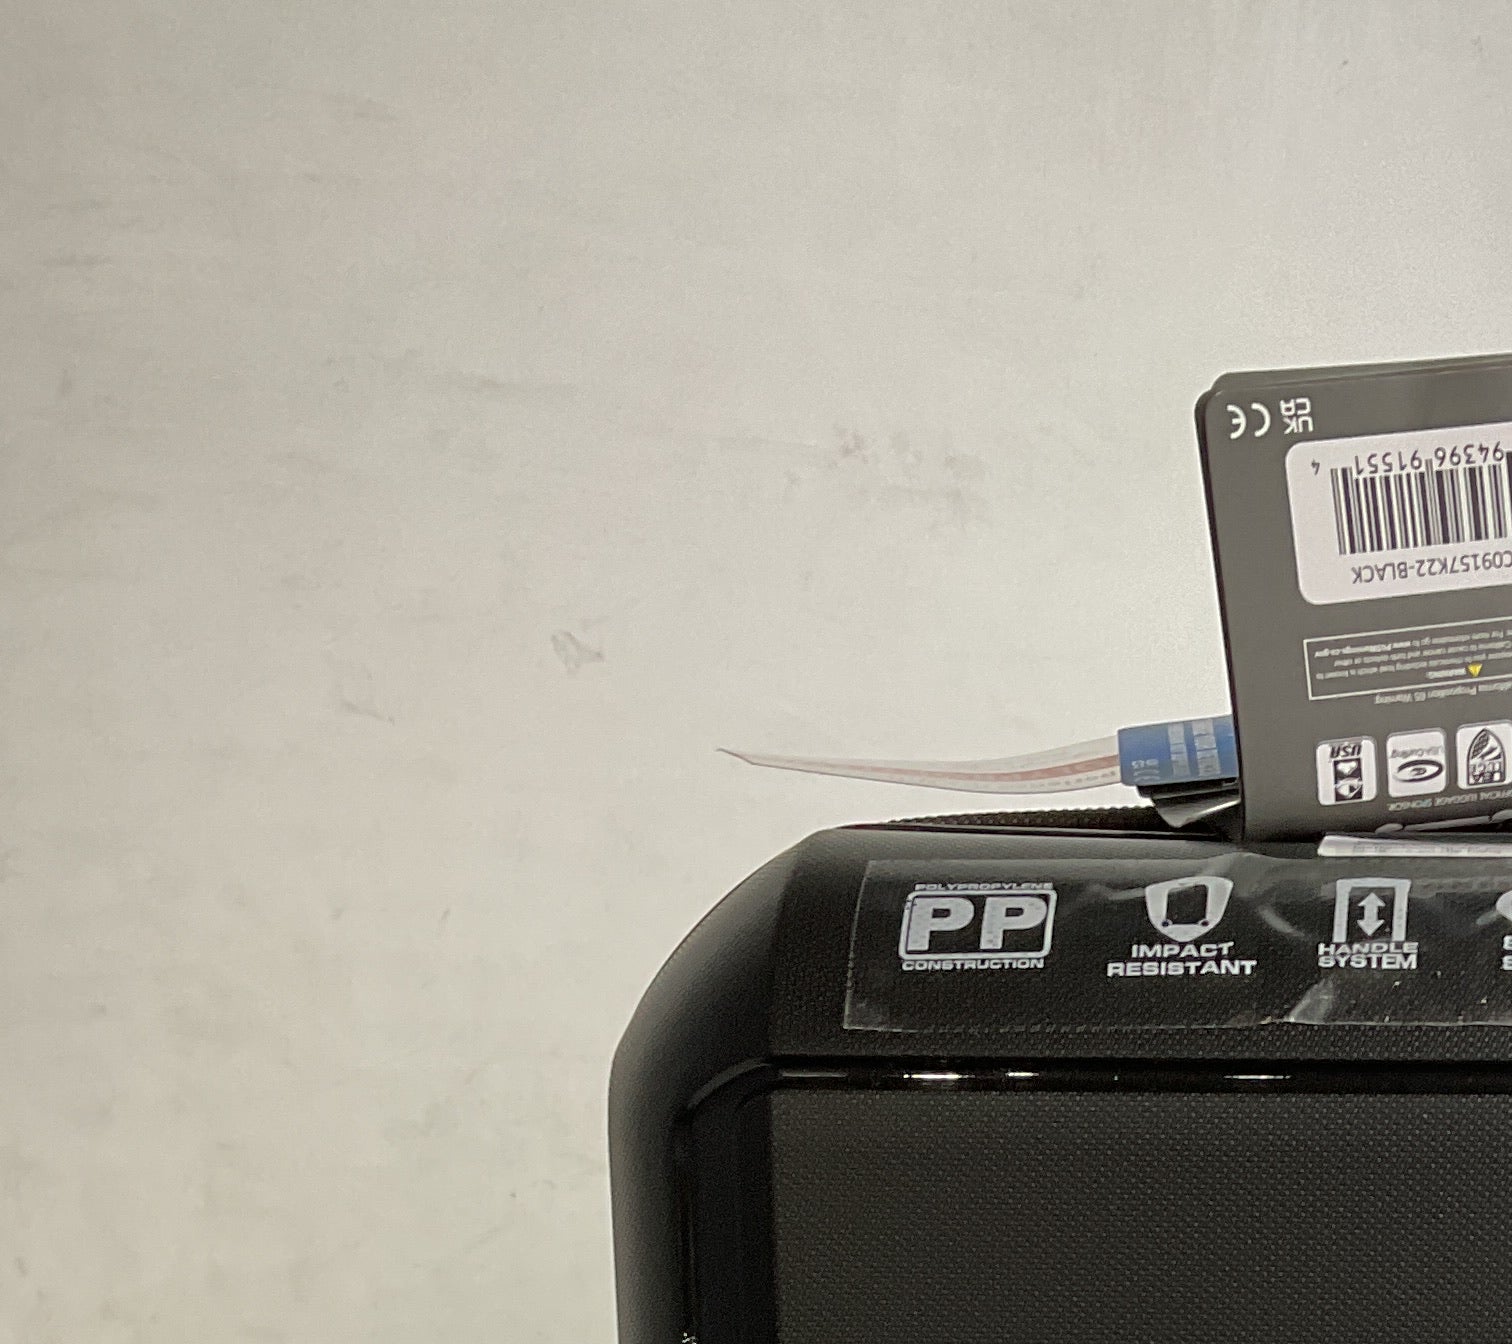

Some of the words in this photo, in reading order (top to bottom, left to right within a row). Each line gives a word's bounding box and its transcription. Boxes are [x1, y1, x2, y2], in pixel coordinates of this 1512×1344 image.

[1280, 398, 1311, 416] CA
[1283, 416, 1313, 434] UK
[1434, 441, 1504, 467] 94396
[1311, 460, 1320, 476] 4
[1354, 451, 1422, 476] 91551
[1329, 744, 1361, 759] USA
[906, 897, 1048, 951] PP
[1131, 941, 1235, 958] IMPACT
[1317, 942, 1419, 955] HANDLE
[902, 958, 1045, 971] CONSTRUCTION
[1106, 960, 1258, 977] RESISTANT
[1317, 953, 1418, 970] SYSTEM
